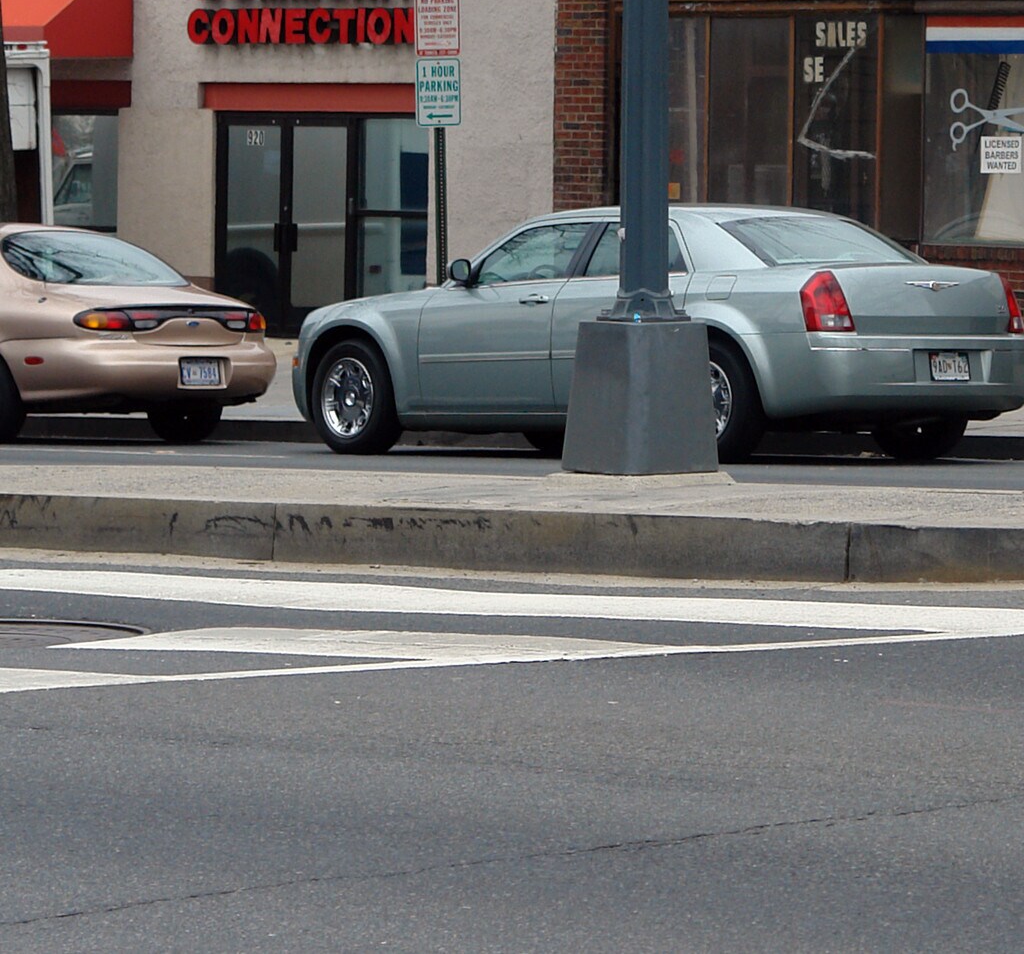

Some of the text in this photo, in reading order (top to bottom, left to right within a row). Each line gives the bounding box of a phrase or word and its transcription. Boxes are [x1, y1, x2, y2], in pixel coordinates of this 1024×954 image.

[187, 7, 415, 44] CONNECTION
[422, 65, 455, 77] 1 HOUR
[419, 80, 459, 92] PARKING
[248, 130, 264, 145] 920
[984, 140, 1020, 148] LICENSED
[984, 151, 1019, 159] BARBERS
[986, 161, 1017, 170] WANTED
